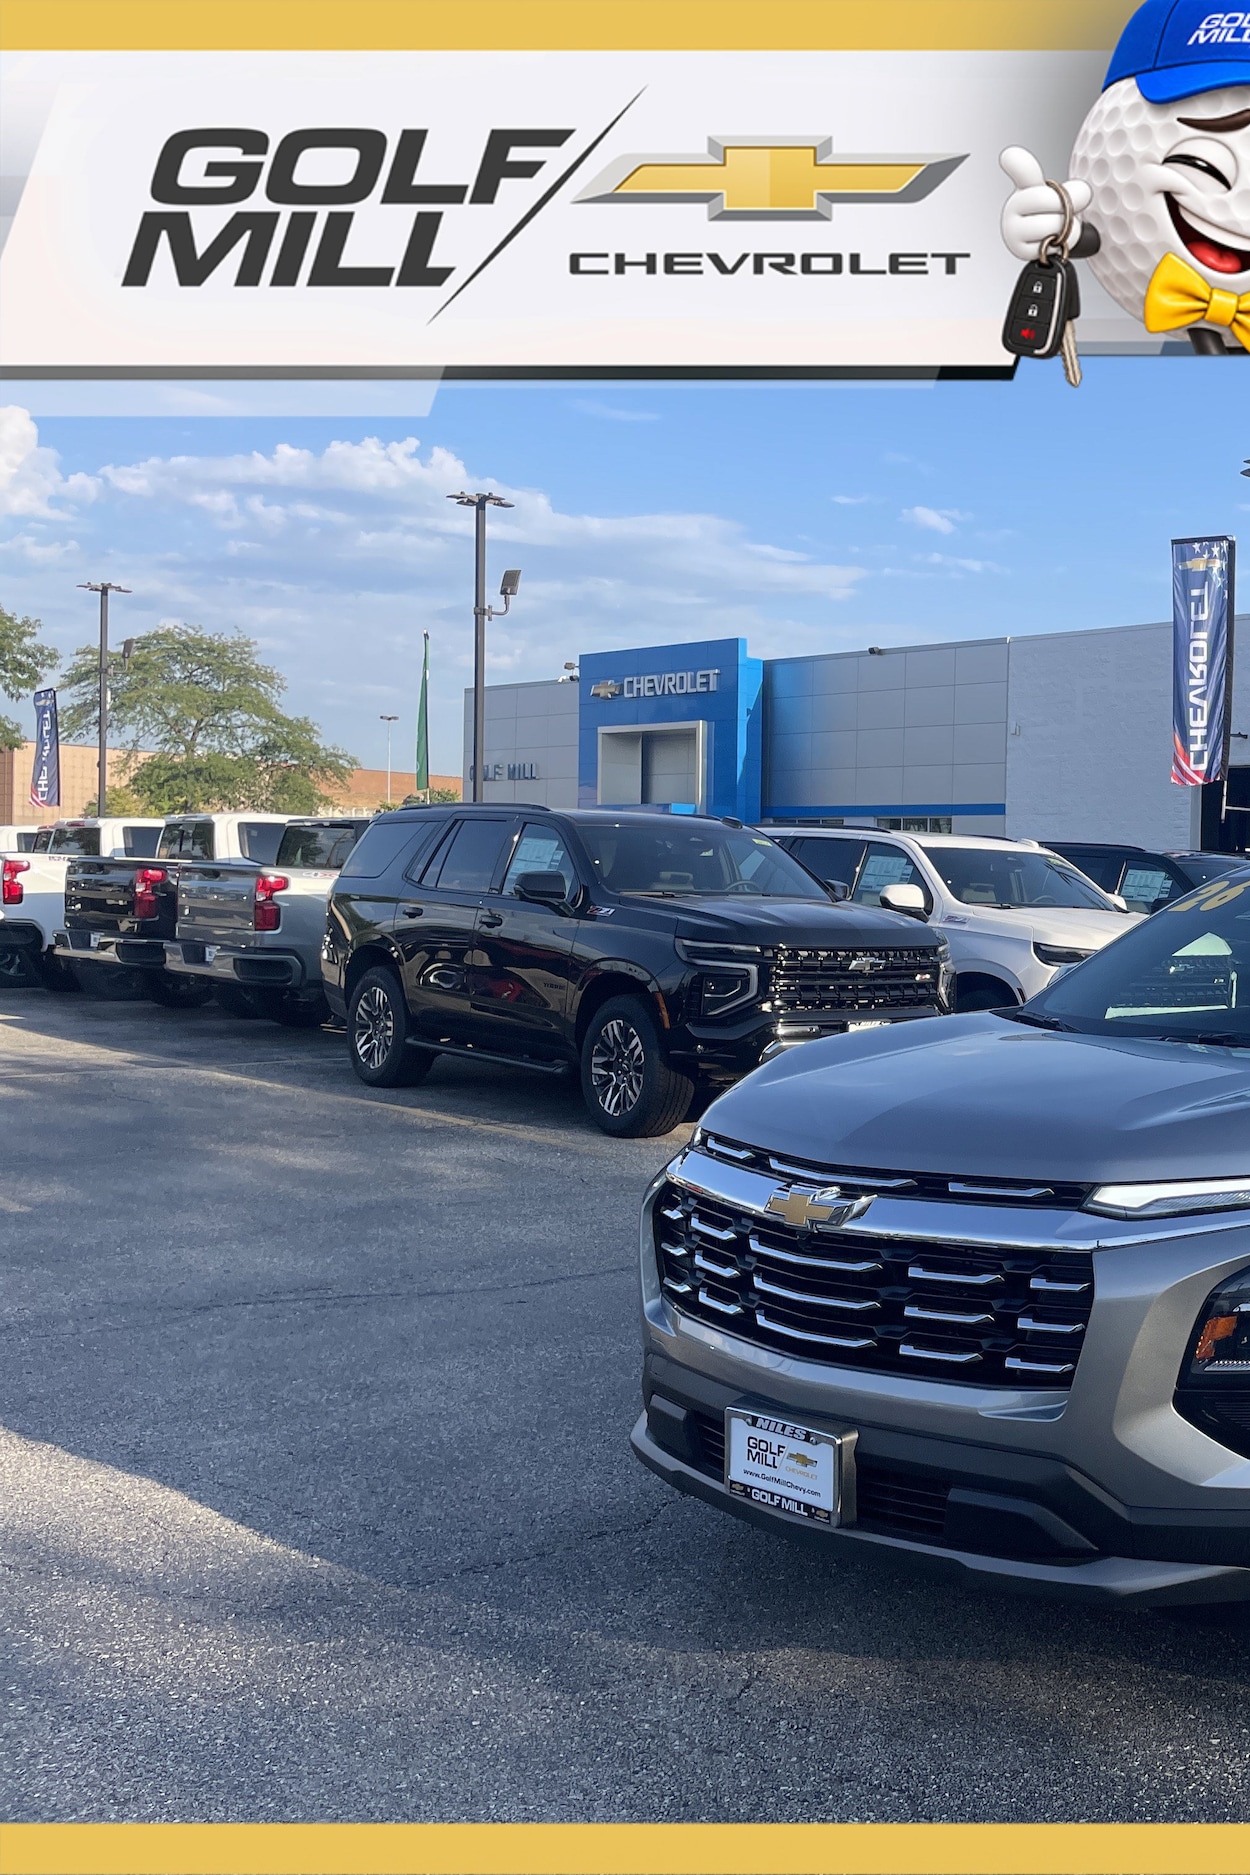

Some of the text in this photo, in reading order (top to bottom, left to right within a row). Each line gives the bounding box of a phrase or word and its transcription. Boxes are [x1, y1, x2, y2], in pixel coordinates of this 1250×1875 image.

[624, 669, 720, 698] CHEVROLET
[507, 763, 537, 781] MILL
[756, 1418, 806, 1440] NILES
[747, 1436, 786, 1457] GOLF
[747, 1449, 778, 1469] MILL
[751, 1488, 808, 1516] GOLF MILL
